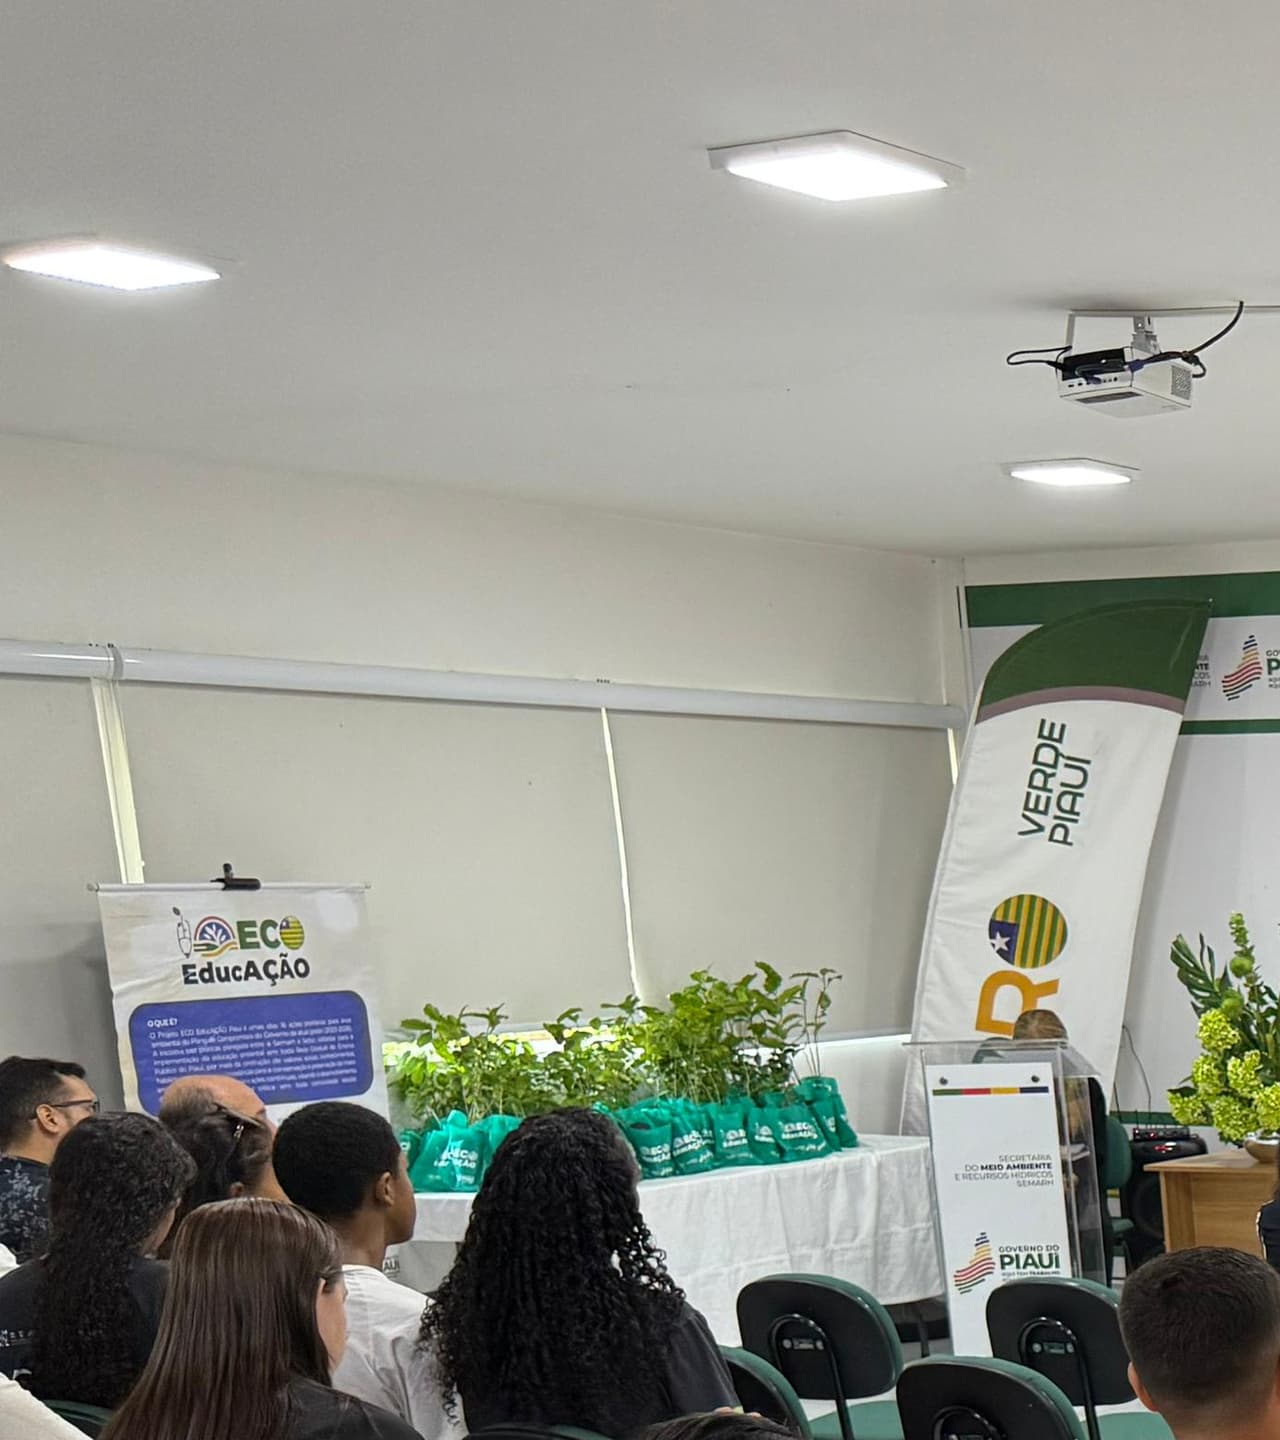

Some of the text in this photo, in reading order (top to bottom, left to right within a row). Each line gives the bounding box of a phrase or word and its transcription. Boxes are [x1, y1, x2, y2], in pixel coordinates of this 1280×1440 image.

[1017, 718, 1067, 837] VERDE
[1048, 752, 1092, 847] PIAUÍ
[182, 953, 310, 986] EducAÇÃO
[1006, 1162, 1052, 1170] AMBIENTE
[1046, 1244, 1060, 1252] DO
[1000, 1252, 1061, 1271] PIAUÍ
